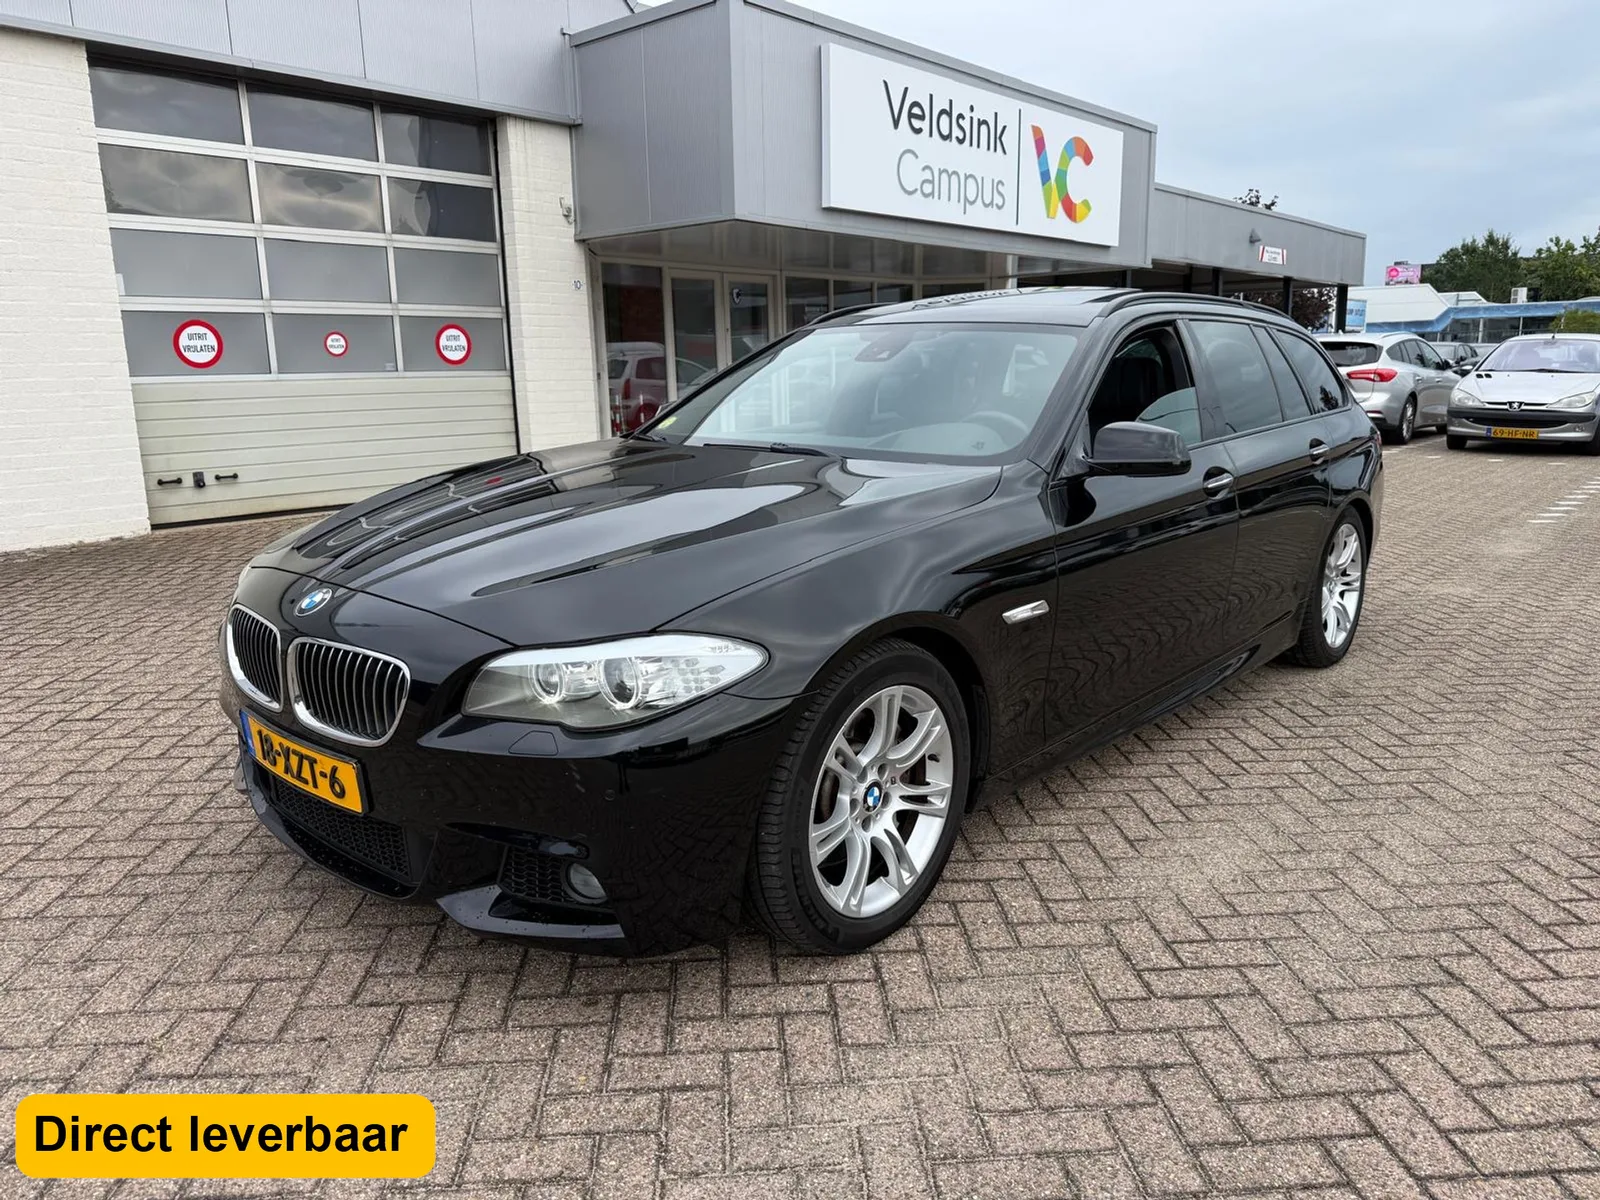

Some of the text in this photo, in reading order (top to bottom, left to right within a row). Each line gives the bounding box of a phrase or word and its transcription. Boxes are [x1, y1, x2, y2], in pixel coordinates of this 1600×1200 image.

[882, 79, 1008, 155] Veldsink
[1031, 125, 1094, 223] VC
[896, 148, 1006, 214] Campus
[573, 280, 582, 290] 10
[187, 332, 208, 341] UITRIT
[445, 334, 461, 342] UITRIT
[182, 344, 216, 353] VRIJLATEN
[1492, 428, 1536, 438] 69-HF-NR
[257, 729, 346, 799] 18-XZT-6
